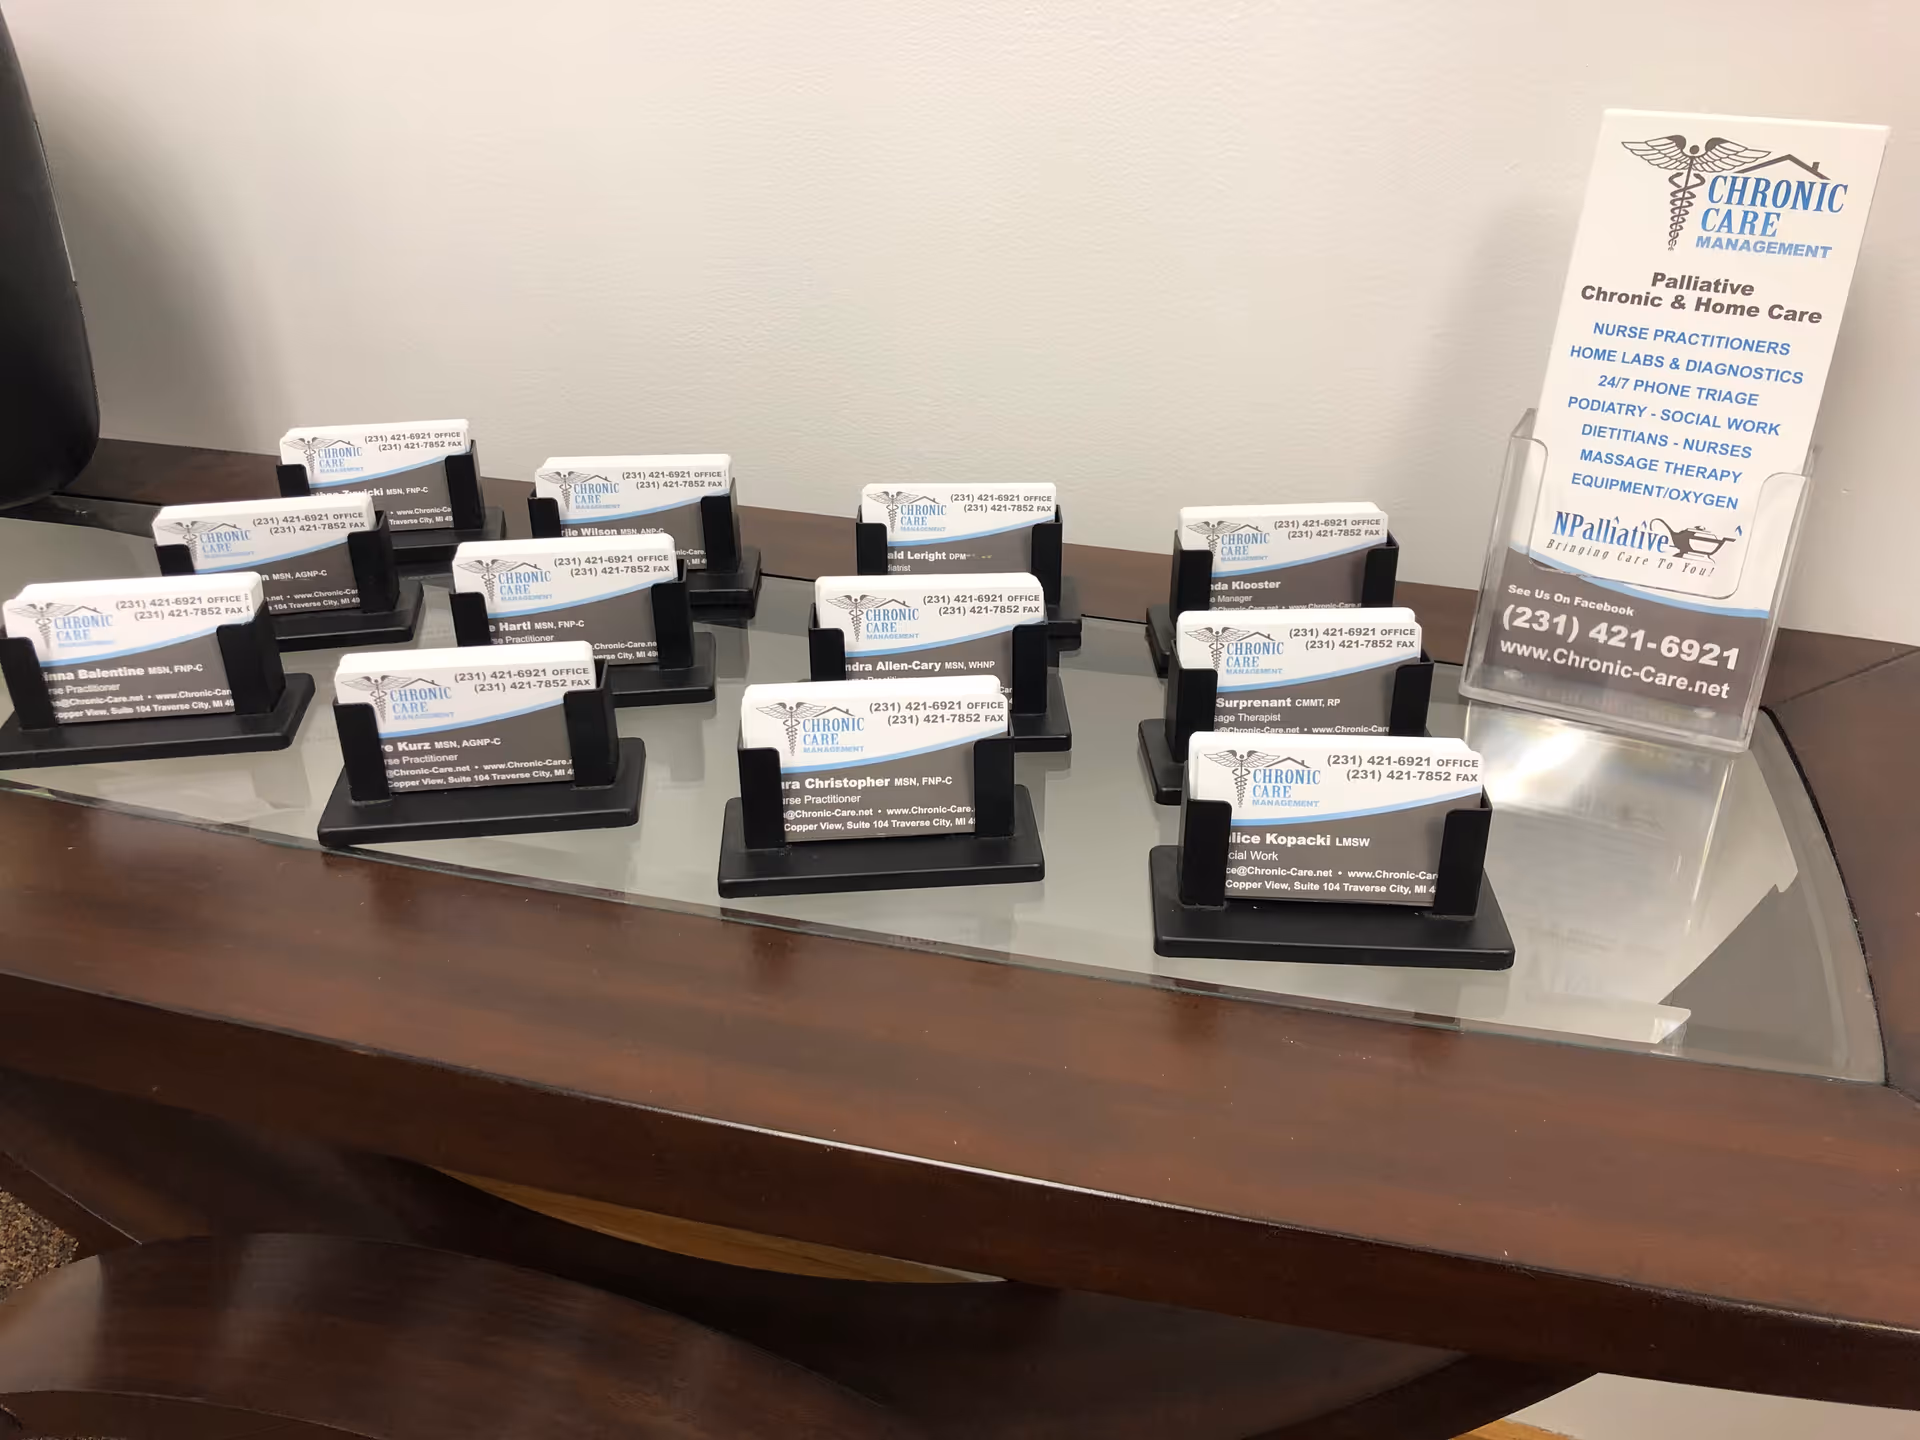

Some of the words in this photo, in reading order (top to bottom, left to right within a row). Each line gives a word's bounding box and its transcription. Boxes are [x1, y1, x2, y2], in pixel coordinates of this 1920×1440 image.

[1708, 175, 1848, 213] CHRONIC
[1701, 207, 1781, 238] CARE
[1695, 236, 1832, 259] MANAGEMENT
[1651, 272, 1755, 296] Palliative
[1581, 285, 1663, 308] Chronic
[1670, 295, 1686, 310] &
[1695, 297, 1760, 317] Home
[1768, 303, 1822, 324] Care
[1593, 322, 1649, 340] NURSE
[1653, 329, 1791, 356] PRACTITIONERS
[1570, 345, 1617, 362] HOME
[1621, 352, 1665, 368] LABS
[1669, 357, 1681, 370] &
[1685, 359, 1804, 385] DIAGNOSTICS
[1598, 375, 1630, 389] 24/7
[1633, 380, 1691, 398] PHONE
[1696, 387, 1759, 406] TRIAGE
[1568, 396, 1648, 418] PODIATRY
[1660, 408, 1721, 429] SOCIAL
[1727, 417, 1781, 436] WORK
[365, 435, 388, 444] (231)
[390, 432, 431, 441] 421-6921
[1582, 423, 1669, 447] DIETITIANS
[1683, 438, 1752, 459] NURSES
[318, 447, 362, 458] CHRONIC
[319, 459, 344, 467] CARE
[1580, 449, 1659, 472] MASSAGE
[1664, 461, 1742, 484] THERAPY
[649, 470, 690, 478] 421-6921
[386, 488, 404, 496] MSN,
[1571, 472, 1738, 510] EQUIPMENT/OXYGEN
[950, 494, 974, 502] (231)
[977, 494, 1020, 502] 421-6921
[964, 504, 987, 512] (231)
[991, 504, 1034, 512] 421-7852
[252, 517, 279, 527] (231)
[282, 513, 329, 524] 421-6921
[1274, 521, 1299, 530] (231)
[1302, 519, 1347, 527] 421-6921
[270, 526, 296, 535] (231)
[299, 522, 346, 532] 421-7852
[581, 528, 617, 536] Wilson
[1221, 533, 1269, 545] CHRONIC
[908, 551, 946, 561] Leright
[1221, 546, 1248, 555] CARE
[554, 557, 581, 567] (231)
[584, 555, 633, 564] 421-6921
[637, 554, 669, 562] OFFICE
[1546, 539, 1610, 560] Bringing
[1617, 552, 1649, 565] Care
[1658, 558, 1672, 570] To
[1682, 563, 1715, 577] You!
[272, 573, 294, 581] MSN,
[295, 570, 327, 578] AGNP-C
[498, 571, 551, 584] CHRONIC
[500, 585, 530, 595] CARE
[1232, 581, 1281, 590] Klooster
[116, 600, 145, 610] (231)
[150, 597, 202, 607] 421-6921
[207, 595, 241, 603] OFFICE
[923, 595, 950, 605] (231)
[954, 594, 1002, 603] 421-6921
[1508, 584, 1531, 597] See
[1535, 588, 1551, 600] Us
[1554, 593, 1570, 604] On
[1574, 597, 1634, 616] Facebook
[866, 608, 919, 621] CHRONIC
[499, 621, 531, 631] Hartl
[558, 619, 584, 628] FNP-C
[866, 622, 896, 633] CARE
[1289, 628, 1318, 638] (231)
[1323, 628, 1376, 636] 421-6921
[1502, 604, 1579, 643] (231)
[1588, 622, 1740, 670] 421-6921
[78, 667, 144, 679] Balentine
[148, 666, 171, 675] MSN,
[174, 663, 203, 673] FNP-C
[877, 661, 941, 671] Allen-Cary
[1500, 640, 1730, 699] www.Chronic-Care.net
[454, 672, 486, 682] (231)
[490, 669, 547, 679] 421-6921
[474, 682, 505, 693] (231)
[510, 679, 567, 689] 421-7852
[869, 703, 901, 713] (231)
[905, 701, 962, 711] 421-6921
[1216, 697, 1291, 710] Surprenant
[1296, 699, 1325, 708] CMMT,
[1238, 713, 1281, 723] Therapist
[803, 718, 865, 732] CHRONIC
[397, 742, 431, 751] Kurz
[435, 741, 460, 749] MSN,
[462, 738, 501, 747] AGNP-C
[803, 734, 838, 745] CARE
[403, 753, 458, 764] Practitioner
[1327, 754, 1362, 766] (231)
[1367, 756, 1430, 766] 421-6921
[1436, 758, 1478, 768] OFFICE
[448, 775, 471, 783] Suite
[474, 773, 490, 781] 104
[492, 771, 530, 780] Traverse
[533, 770, 552, 779] City,
[554, 769, 566, 777] MI
[1252, 769, 1320, 784] CHRONIC
[1346, 769, 1382, 782] (231)
[1386, 770, 1451, 781] 421-7852
[1456, 772, 1478, 782] FAX
[805, 777, 890, 789] Christopher
[894, 777, 919, 786] MSN,
[922, 776, 952, 785] FNP-C
[1252, 785, 1292, 798] CARE
[804, 794, 861, 804] Practitioner
[1252, 800, 1319, 808] MANAGEMENT
[784, 823, 818, 832] Copper
[820, 821, 844, 830] View,
[847, 820, 872, 829] Suite
[892, 818, 930, 827] Traverse
[933, 817, 952, 827] City,
[955, 817, 966, 826] MI
[1266, 833, 1330, 847] Kopacki
[1336, 837, 1370, 846] LMSW
[1250, 850, 1278, 861] Work
[1226, 880, 1262, 890] Copper
[1264, 880, 1290, 890] View,
[1294, 882, 1320, 890] Suite
[1322, 882, 1340, 891] 104
[1343, 882, 1386, 893] Traverse
[1389, 884, 1412, 894] City,
[1414, 885, 1427, 893] MI
